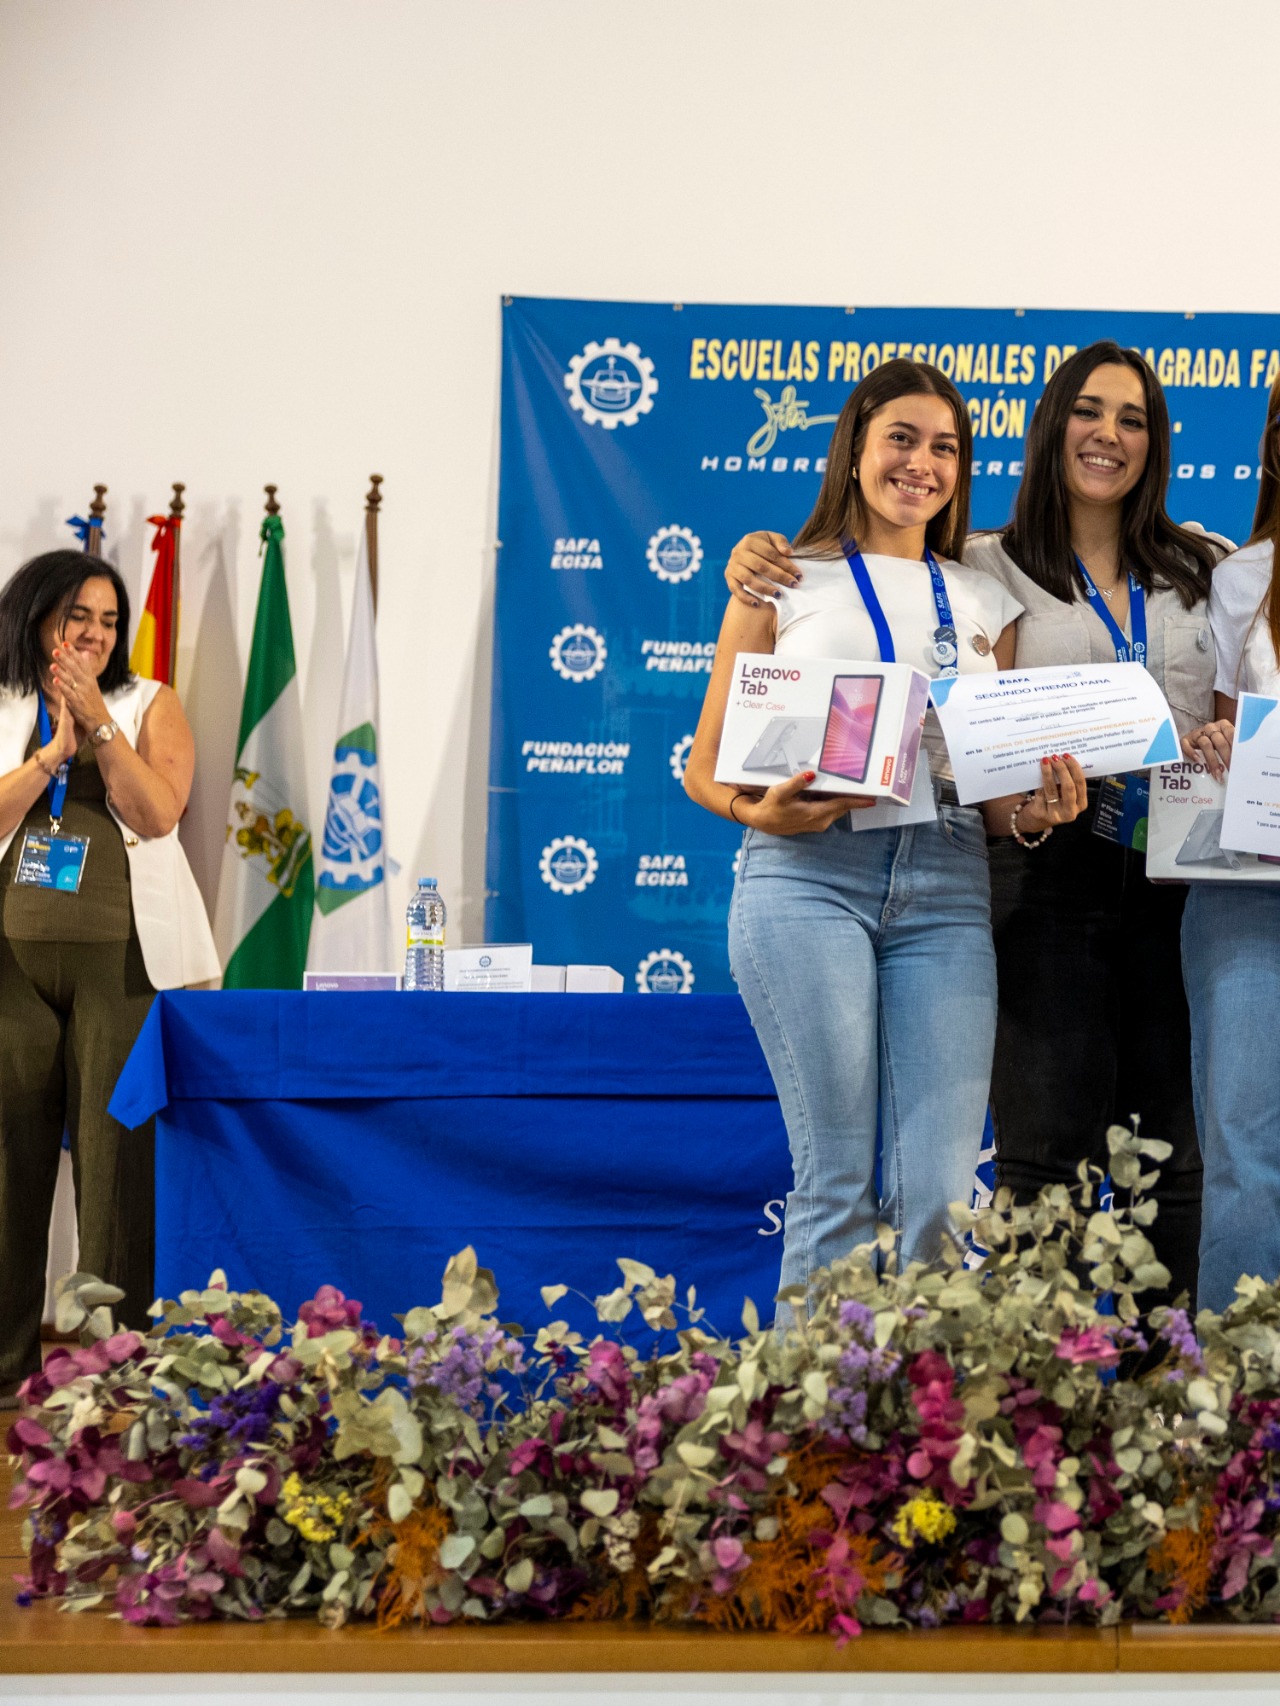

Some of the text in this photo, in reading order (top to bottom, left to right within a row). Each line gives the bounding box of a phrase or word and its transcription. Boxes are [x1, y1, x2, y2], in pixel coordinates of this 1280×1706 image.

[690, 338, 820, 382] ESCUELAS
[1043, 345, 1078, 385] D
[701, 456, 828, 473] HOMBRE
[554, 538, 600, 553] SAFA
[935, 592, 945, 609] SAFA
[641, 639, 716, 657] FUNDAC
[645, 655, 713, 673] PEÑAFL
[742, 663, 801, 681] Lenovo
[740, 680, 768, 696] Tab
[974, 678, 1112, 700] SEGUNDO PREMIO PARA
[743, 700, 764, 711] Clear
[765, 702, 786, 711] Case
[521, 741, 630, 758] FUNDACIÓN
[526, 757, 624, 774] PEÑAFLOR
[882, 758, 892, 784] Lenovo
[1159, 776, 1191, 790] Tab
[1166, 795, 1189, 804] Clear
[1191, 795, 1213, 804] Case
[638, 855, 686, 870] SAFA
[315, 982, 339, 990] Lenovo
